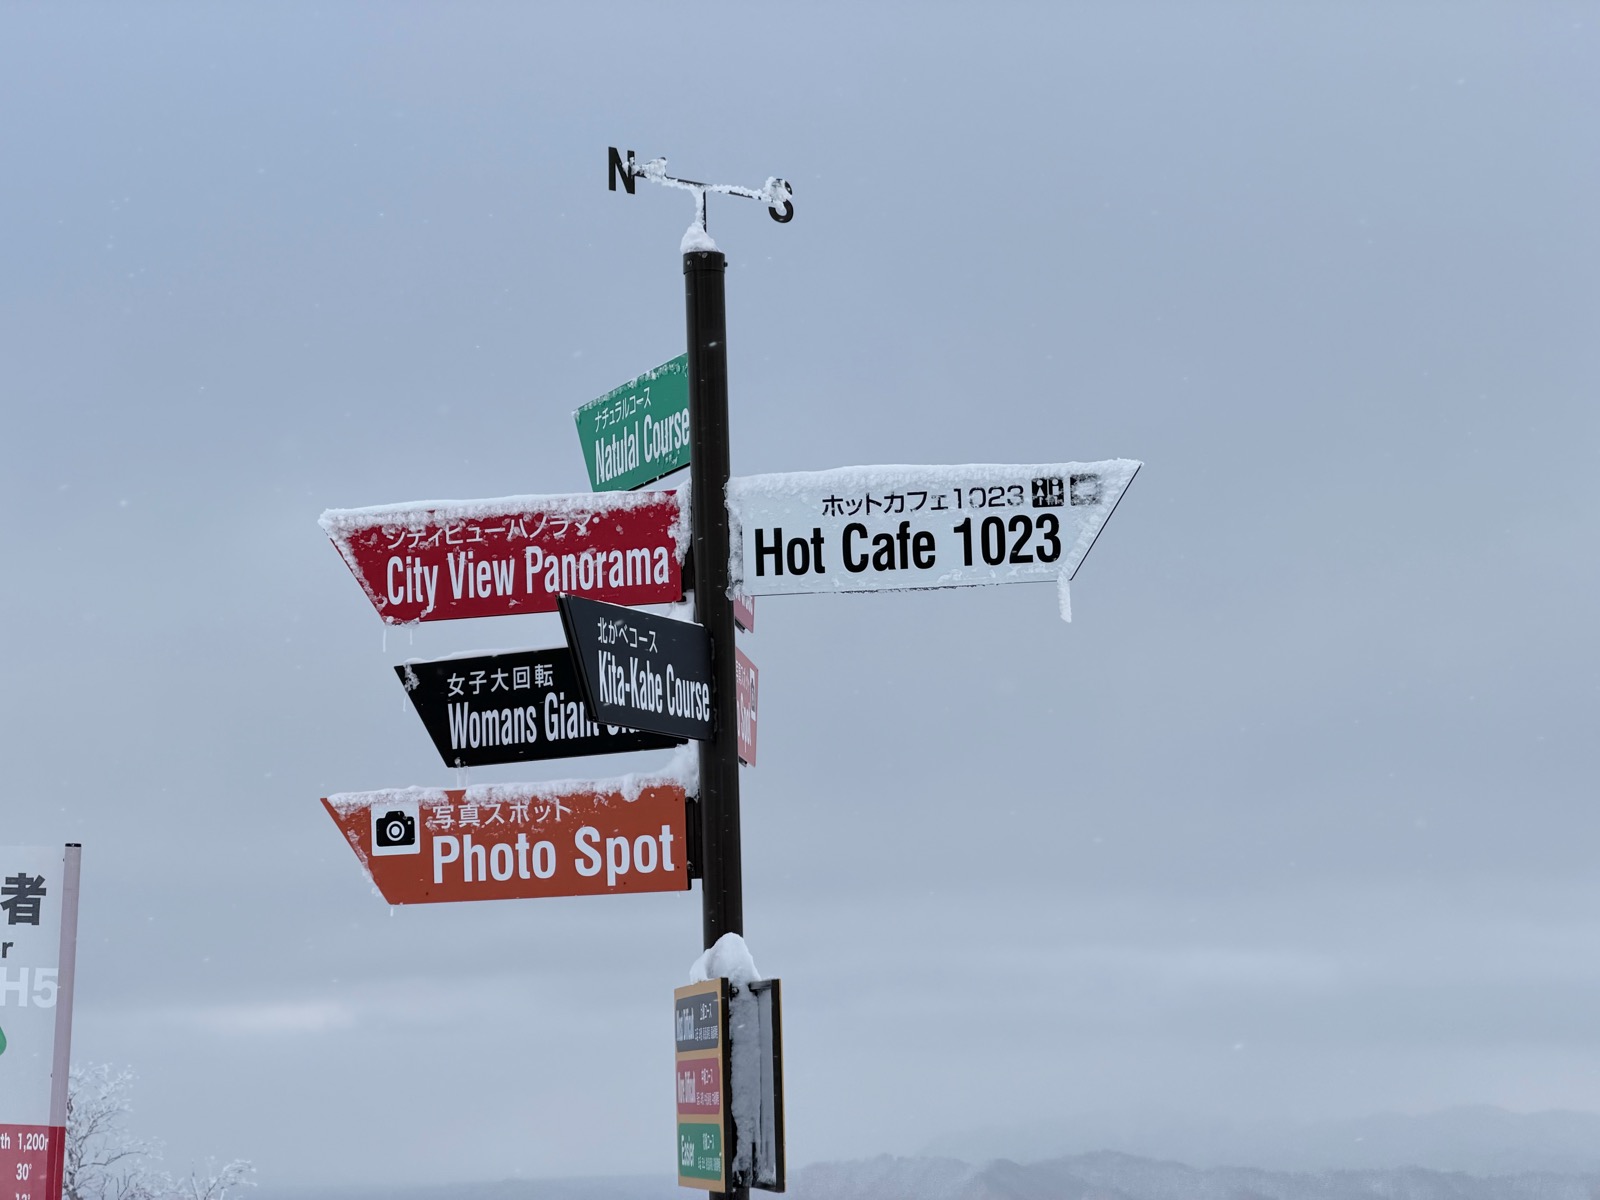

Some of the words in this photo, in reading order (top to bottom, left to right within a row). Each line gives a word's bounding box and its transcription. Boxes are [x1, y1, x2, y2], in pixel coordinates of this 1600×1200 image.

[608, 146, 636, 195] N
[594, 386, 652, 433] ナチュラルコース
[595, 420, 640, 486] Natulal
[643, 407, 690, 463] Course
[821, 485, 1025, 517] ホットカフェ1023
[754, 526, 826, 577] Hot
[841, 520, 937, 574] Cafe
[953, 513, 1063, 567] 1023
[386, 555, 439, 613] City
[447, 550, 516, 600] View
[525, 545, 670, 594] Panorama
[597, 616, 659, 654] 北かべコース
[446, 663, 554, 697] 女子大回転
[598, 650, 664, 714] Kita-Kabe
[665, 663, 711, 722] Course
[447, 699, 538, 750] Womans
[431, 799, 572, 829] 写真スポット
[432, 832, 557, 884] Photo
[574, 824, 675, 887] Spot
